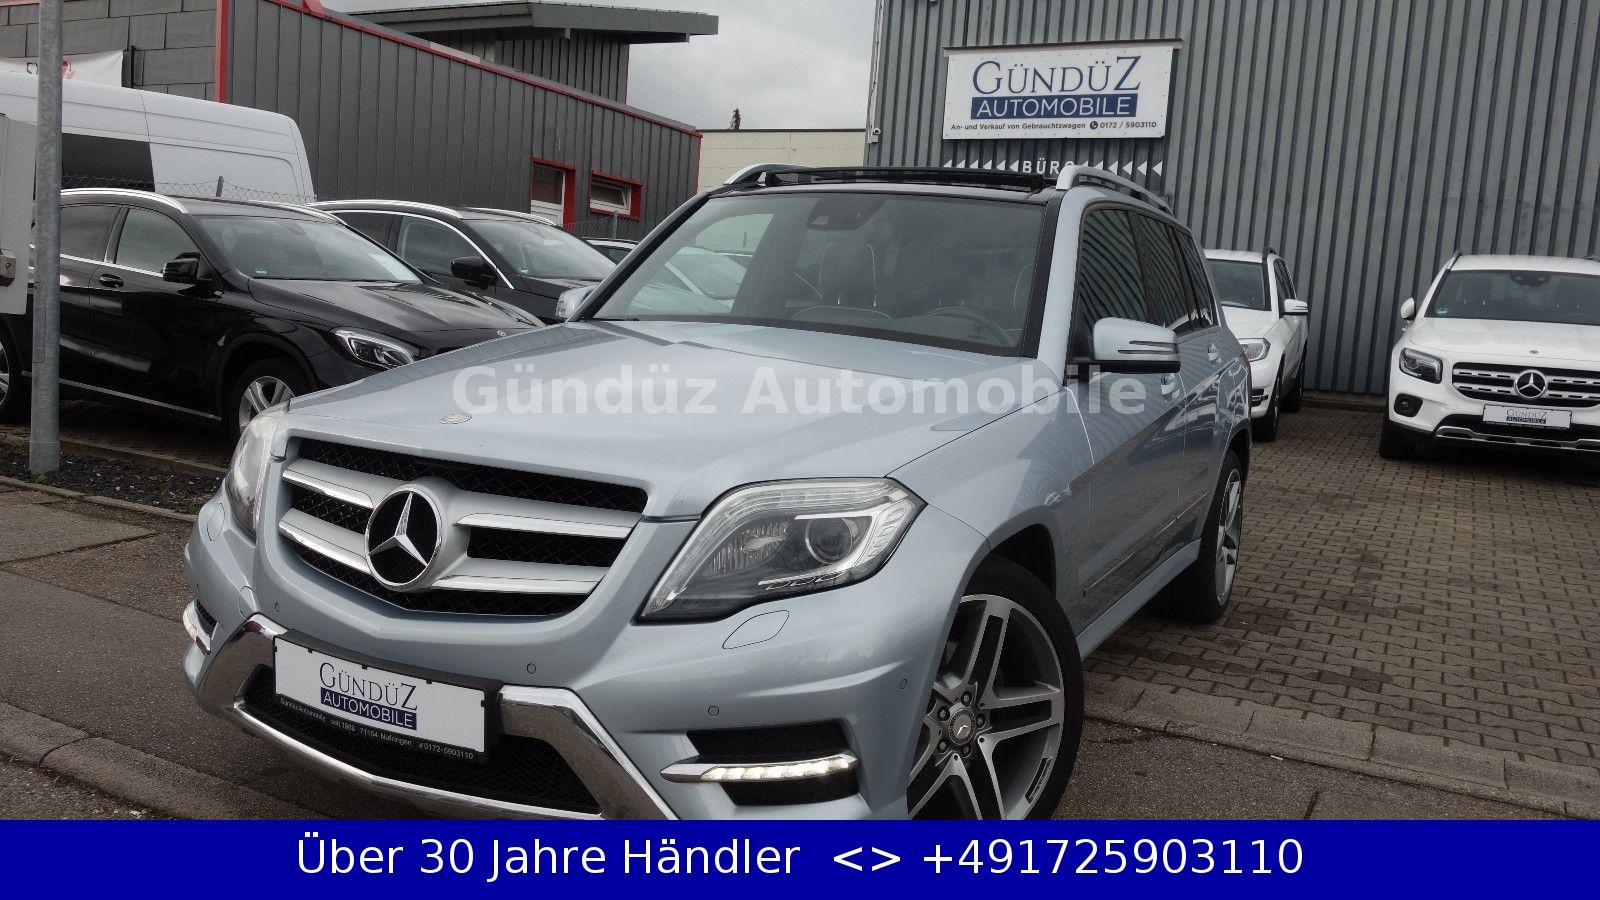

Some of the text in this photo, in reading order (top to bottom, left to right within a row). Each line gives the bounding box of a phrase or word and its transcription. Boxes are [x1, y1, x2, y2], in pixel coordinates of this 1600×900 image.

[972, 55, 1142, 95] GÜNDÜZ
[976, 96, 1131, 117] AUTOMOBILE
[1022, 121, 1086, 130] Gebrauchtswagen
[1100, 121, 1117, 129] 0172
[1125, 121, 1157, 129] 5903110
[319, 662, 418, 711] GÜNDÜZ
[323, 691, 413, 728] AUTOMOBILE
